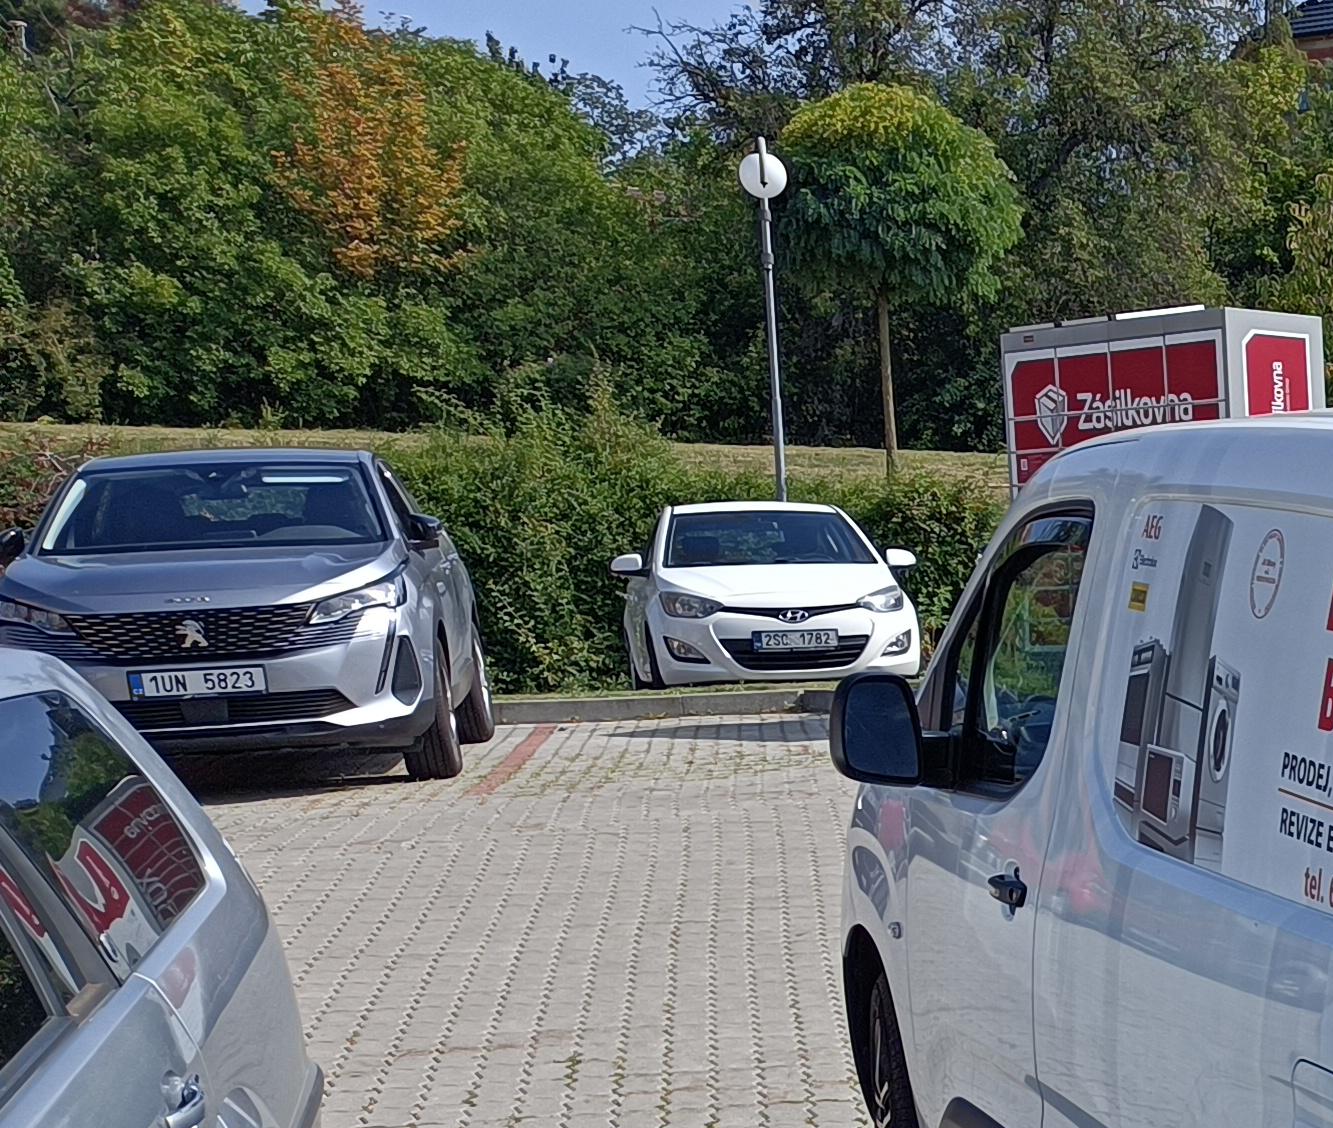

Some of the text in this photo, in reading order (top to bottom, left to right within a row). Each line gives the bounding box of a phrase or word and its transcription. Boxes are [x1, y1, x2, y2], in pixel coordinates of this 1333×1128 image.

[1077, 388, 1193, 430] Zásilkovna
[1142, 514, 1163, 540] AEG
[764, 632, 831, 646] 2SC 1782
[149, 671, 255, 694] 1UN 5823
[1281, 752, 1332, 797] PRODEJ,
[1279, 808, 1324, 848] REVIZE
[1304, 867, 1324, 903] tel.
